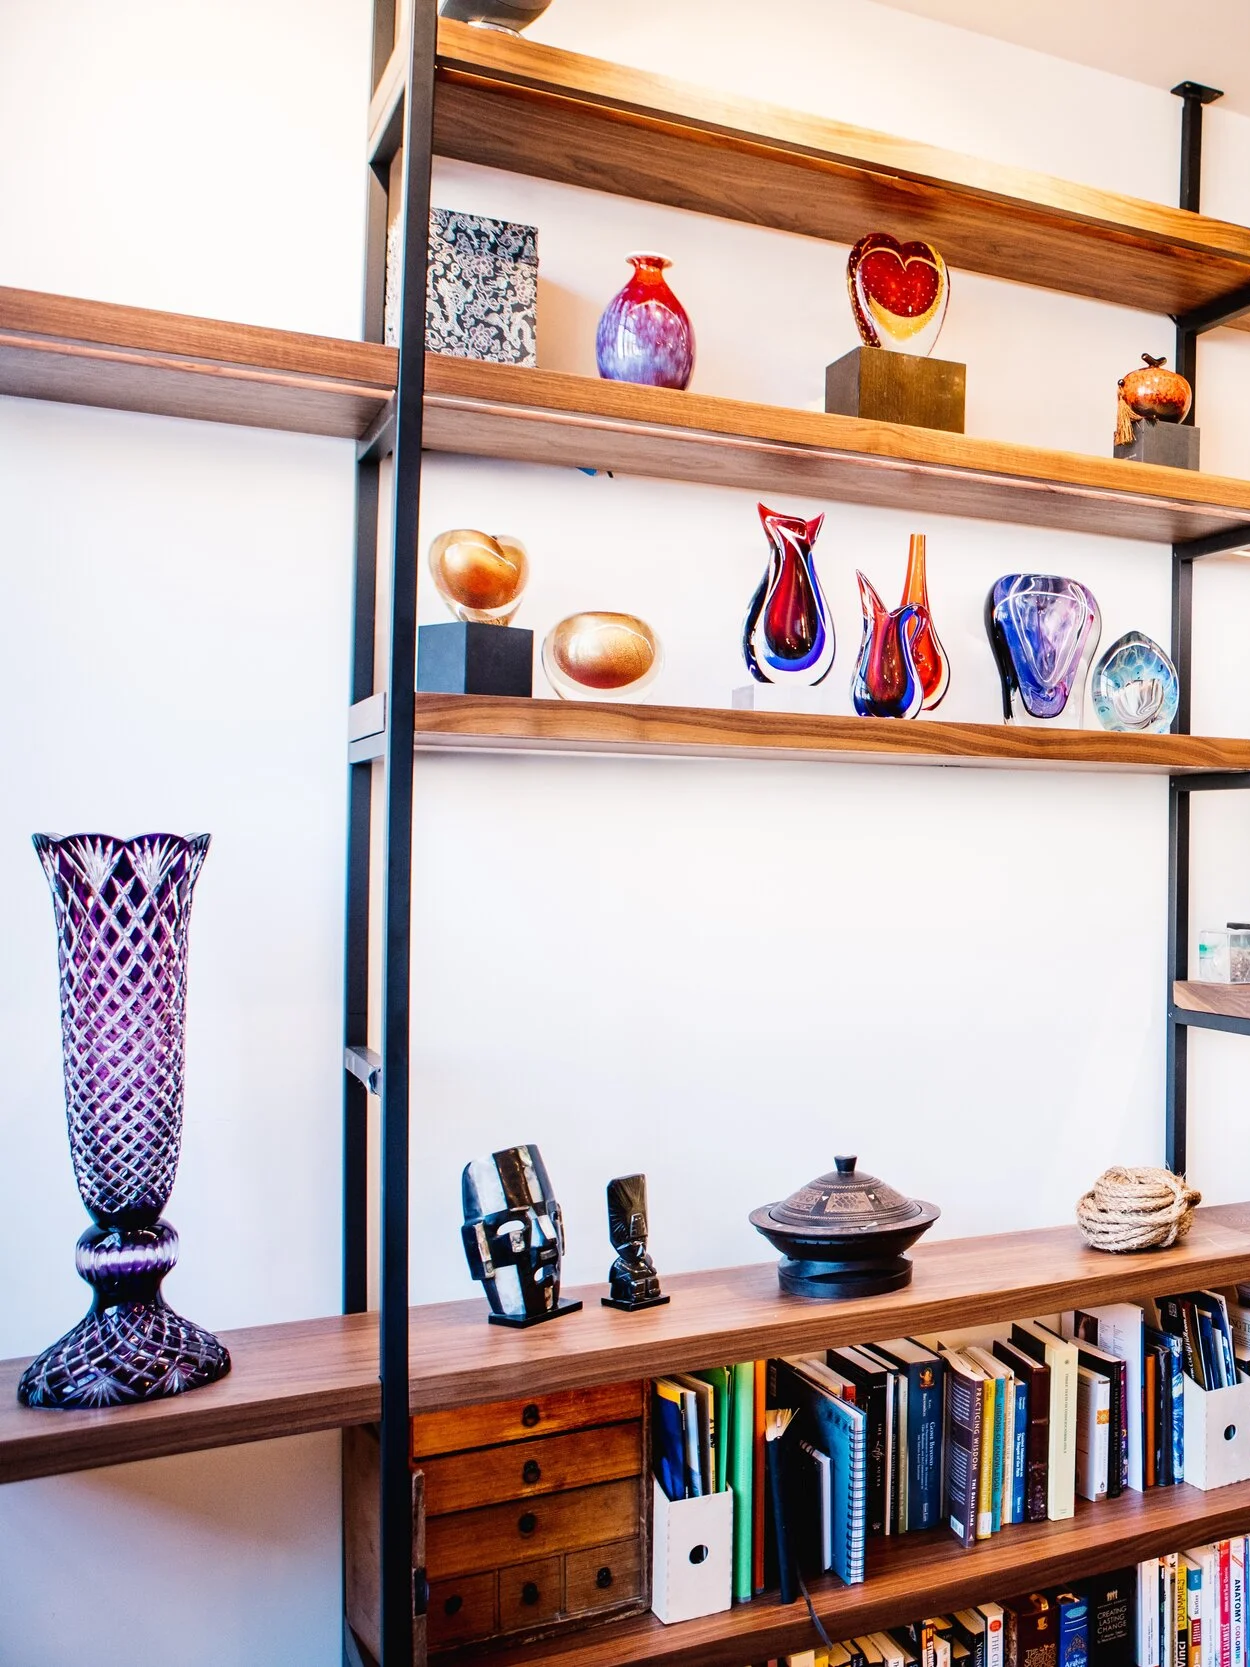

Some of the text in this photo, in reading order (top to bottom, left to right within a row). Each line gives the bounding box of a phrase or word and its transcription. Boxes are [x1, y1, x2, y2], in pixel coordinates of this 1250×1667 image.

[971, 1387, 983, 1471] PRACTICING WISDOM
[993, 1445, 1001, 1493] KNOWLEDGE
[1097, 1606, 1127, 1620] CREATING
[1177, 1578, 1185, 1622] DUMMIES
[1097, 1620, 1127, 1635] CHANGE
[1098, 1614, 1125, 1627] LASTING
[991, 1634, 1000, 1653] THE
[1220, 1623, 1230, 1651] CALMNESS
[1177, 1641, 1186, 1667] Vinci
